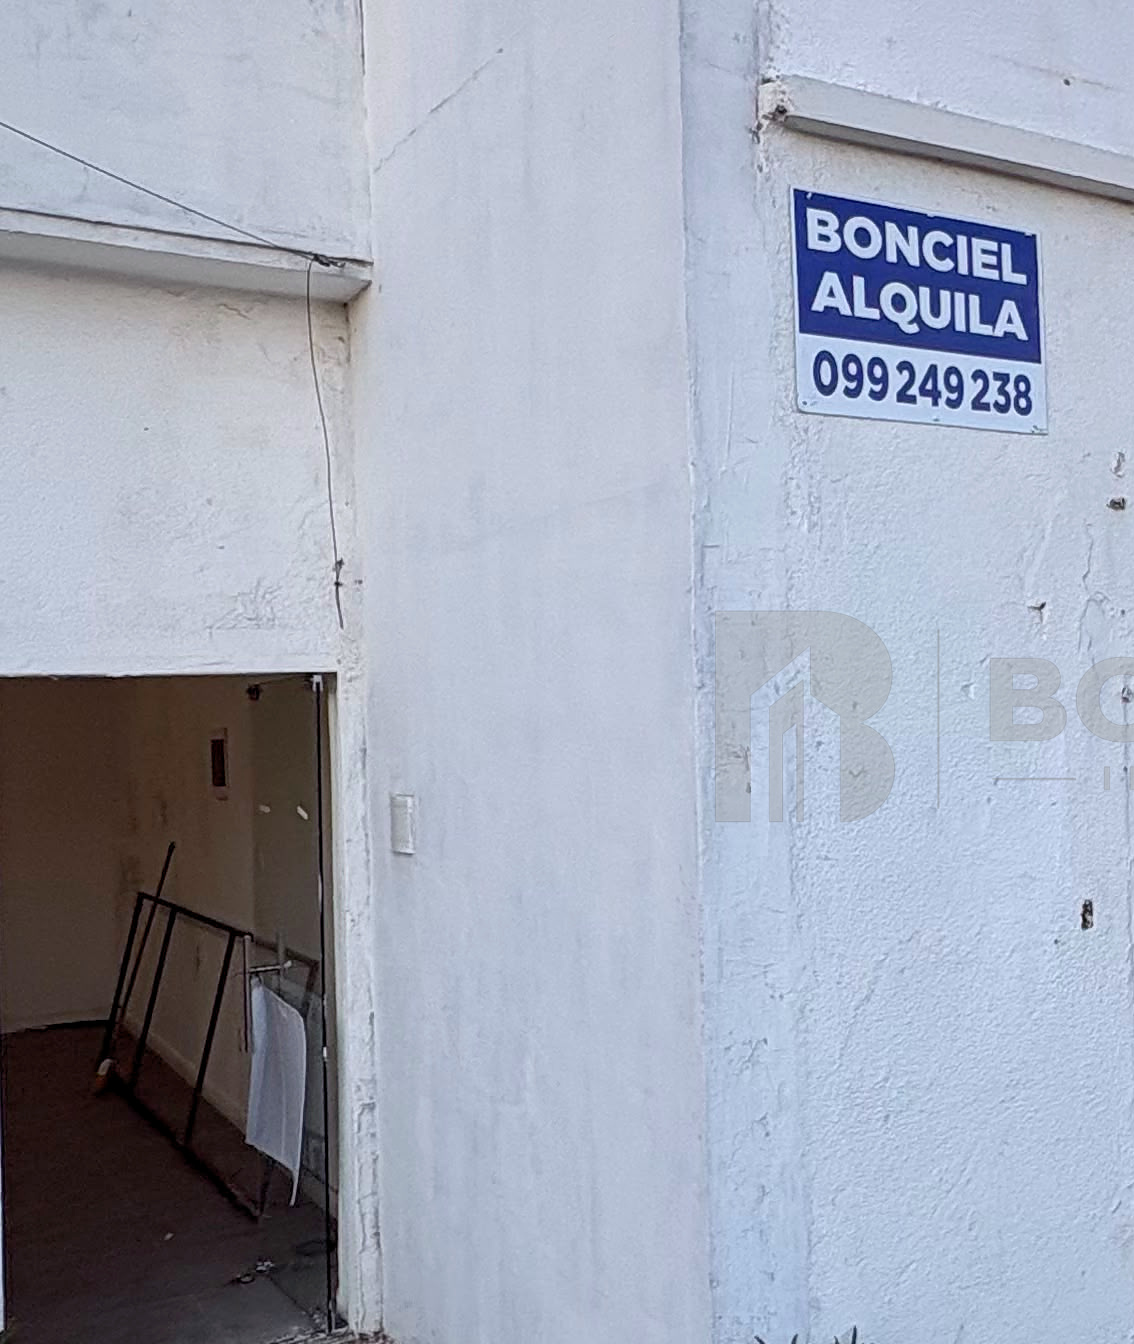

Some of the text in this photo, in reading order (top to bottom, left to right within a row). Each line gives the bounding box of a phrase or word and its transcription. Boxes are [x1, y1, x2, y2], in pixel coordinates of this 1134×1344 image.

[806, 207, 1028, 286] BONCIEL
[811, 271, 1029, 341] ALQUILA
[812, 350, 1033, 417] 099 249 238
